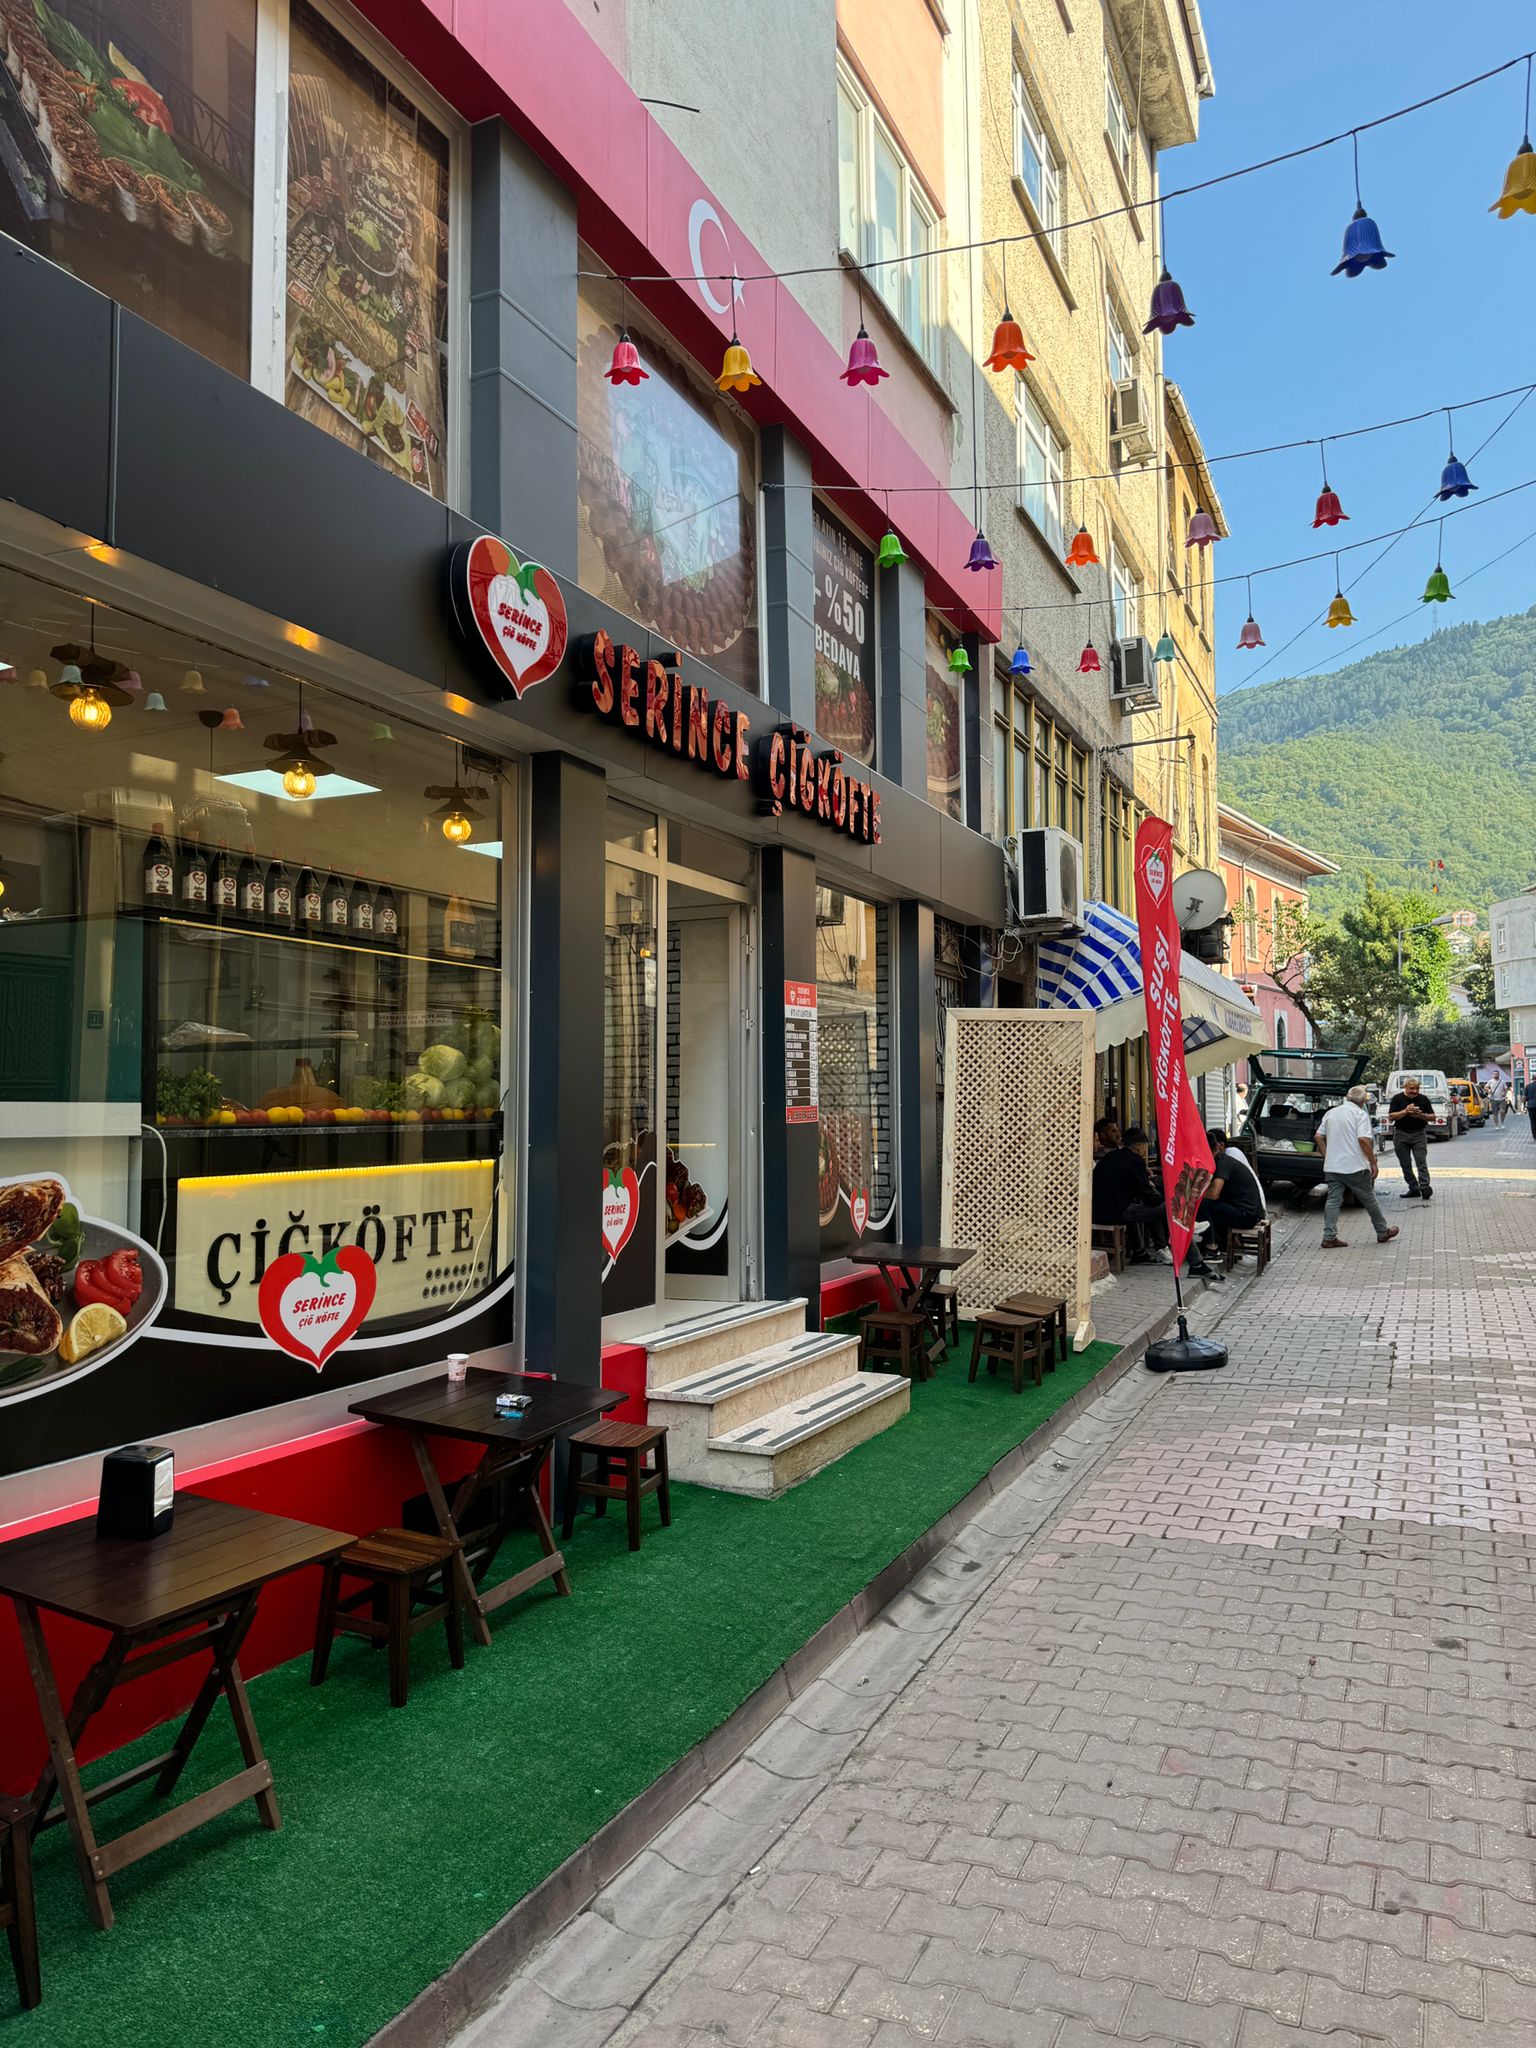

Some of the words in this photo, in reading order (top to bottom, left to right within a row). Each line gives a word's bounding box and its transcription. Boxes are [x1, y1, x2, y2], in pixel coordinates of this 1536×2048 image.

[497, 602, 543, 637] SERİNCE
[502, 624, 516, 639] ÇİĞ
[515, 632, 538, 651] KÖFTE
[825, 574, 865, 645] %50
[815, 623, 861, 682] BEDAVA
[589, 627, 750, 781] SERİNCE
[768, 721, 881, 844] ÇİĞKÖFTE
[1150, 924, 1170, 1010] SUŞİ
[1156, 987, 1178, 1102] ÇİĞKÖFTE
[604, 1202, 626, 1215] SERİNCE
[207, 1205, 474, 1305] ÇİĞKÖFTE
[293, 1293, 347, 1314] SERİNCE
[299, 1314, 314, 1330] ÇİĞ
[315, 1311, 340, 1325] KÖFTE
